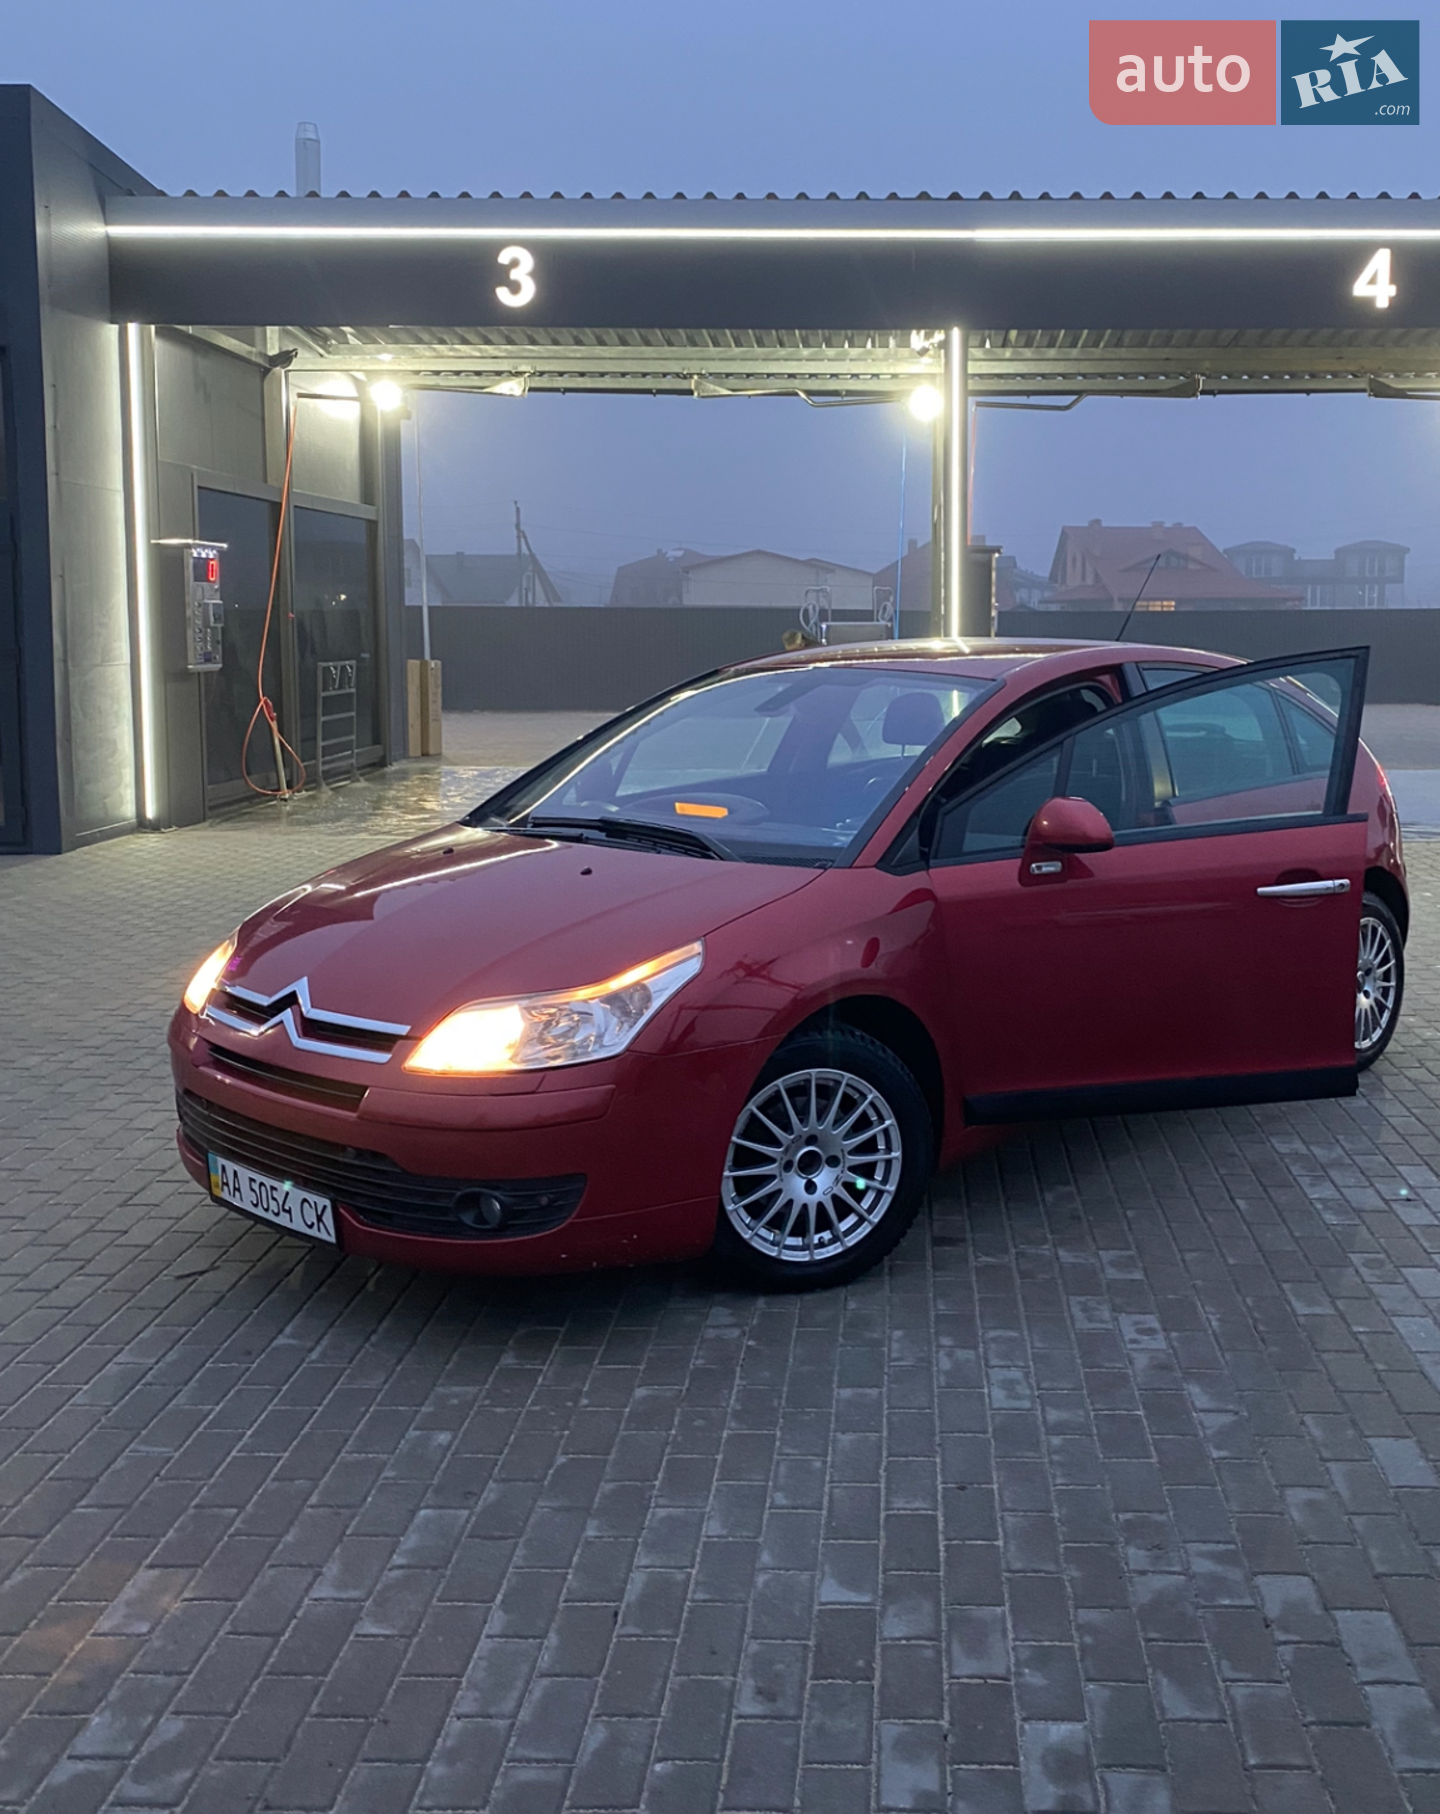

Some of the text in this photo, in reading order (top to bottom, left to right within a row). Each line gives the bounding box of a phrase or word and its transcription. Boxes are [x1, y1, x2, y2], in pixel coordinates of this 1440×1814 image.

[495, 245, 536, 308] 3
[1352, 248, 1397, 309] 4
[220, 1163, 333, 1238] AA 5054 CK
